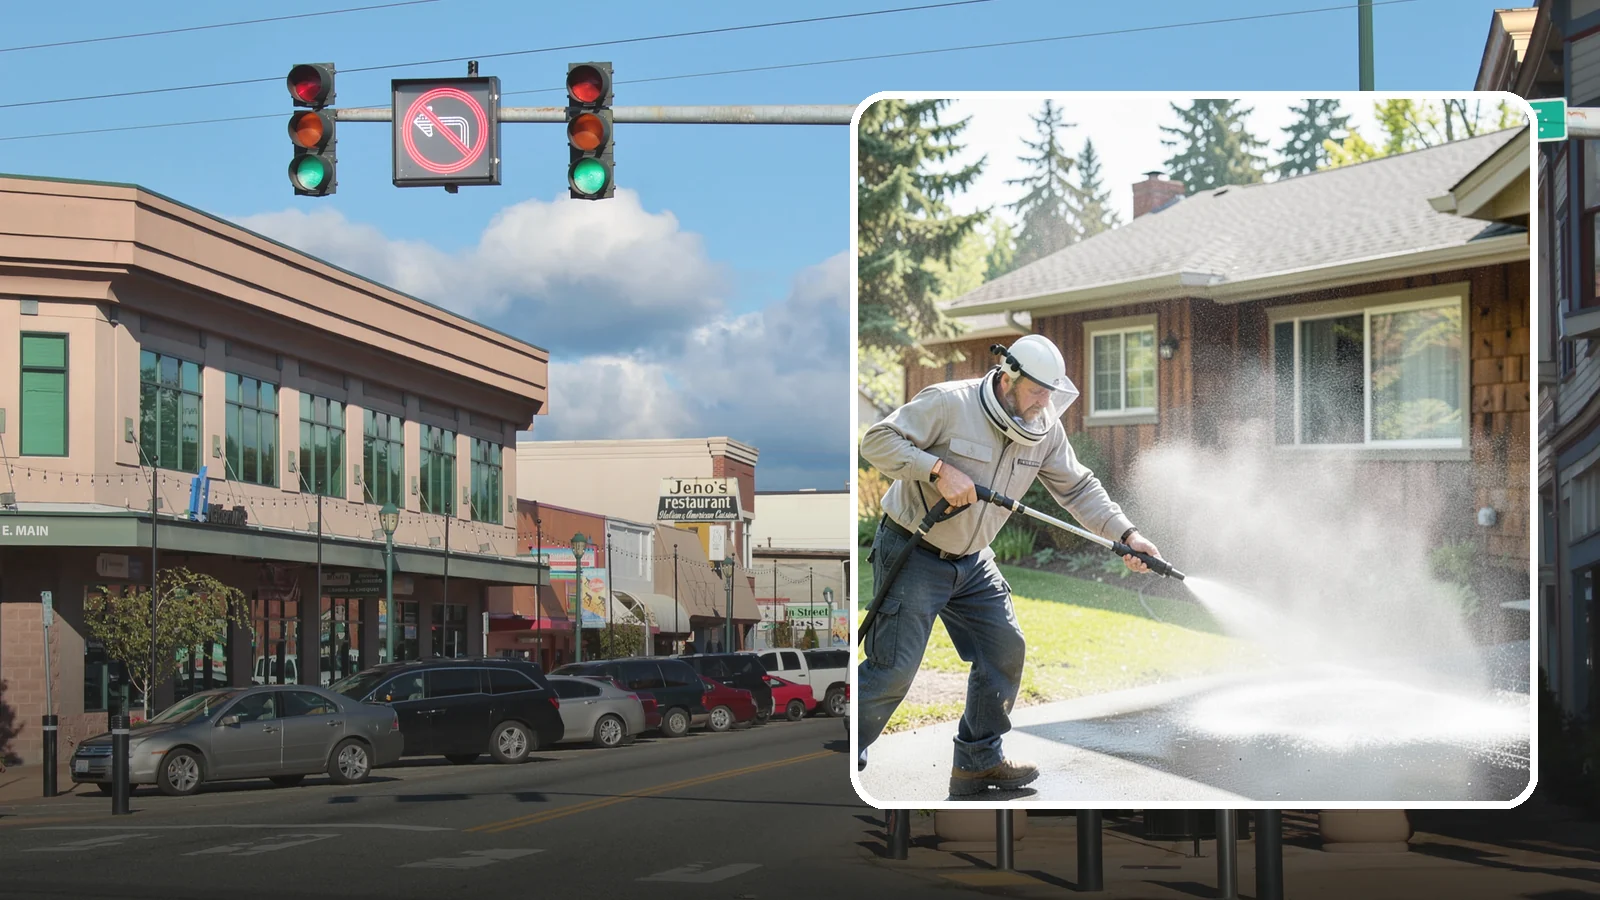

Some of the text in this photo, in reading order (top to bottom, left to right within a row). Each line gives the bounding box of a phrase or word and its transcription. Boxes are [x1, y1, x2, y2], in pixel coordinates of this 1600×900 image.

[669, 480, 727, 495] Jeno's
[665, 496, 731, 509] restaurant
[658, 510, 682, 520] Italian
[686, 510, 714, 519] American
[715, 510, 738, 519] Cuisine
[2, 525, 49, 536] E. MAIN
[797, 608, 828, 617] Street
[791, 619, 823, 627] lass
